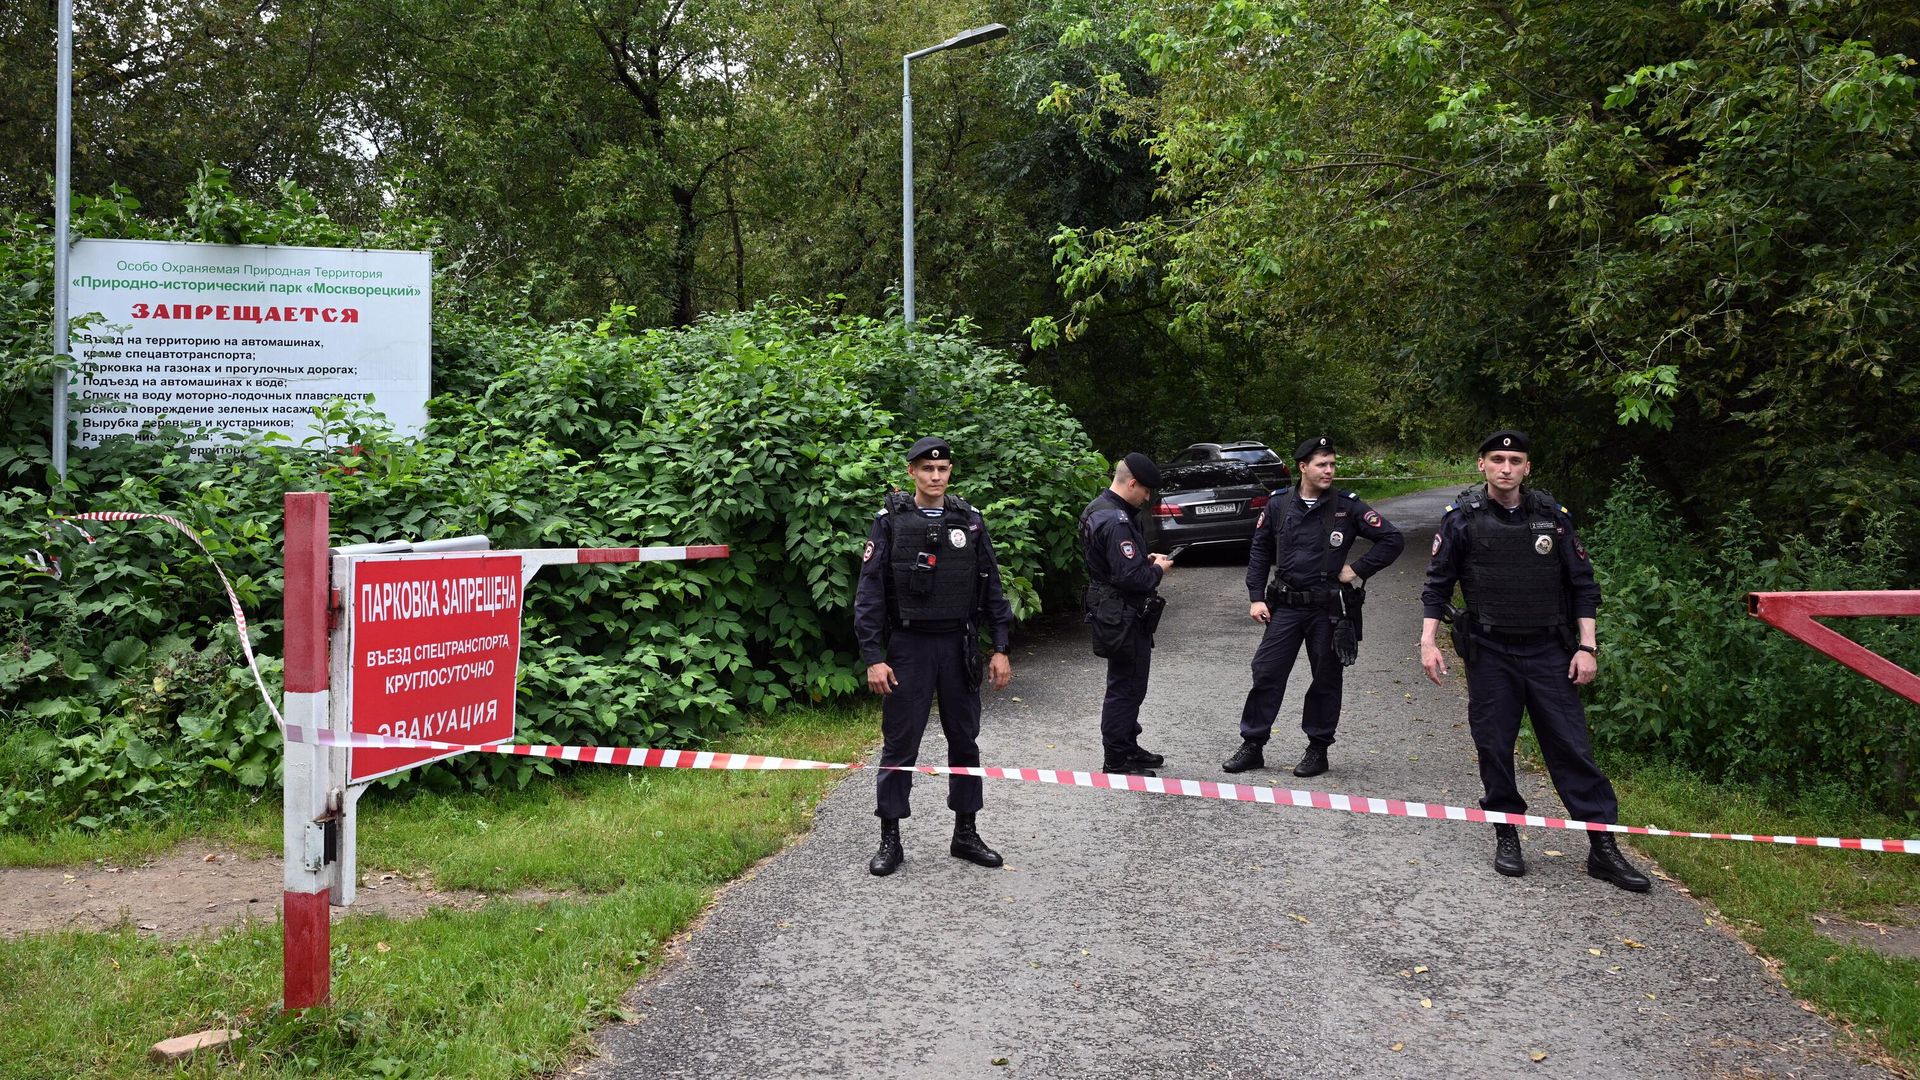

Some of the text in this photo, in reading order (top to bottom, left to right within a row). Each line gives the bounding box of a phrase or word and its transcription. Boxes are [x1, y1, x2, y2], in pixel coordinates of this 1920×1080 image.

[116, 260, 383, 280] Особо Охраняемая Природная Территория
[72, 275, 422, 298] «Природно-исторический парк «Москворецкий»
[131, 303, 360, 324] ЗАПРЕЩАЕТСЯ
[145, 338, 221, 348] территорию
[224, 338, 238, 346] на
[241, 338, 324, 349] автомашинах,
[125, 350, 256, 361] спецавтотранспорта;
[146, 365, 161, 373] на
[164, 365, 211, 373] газонах
[225, 365, 304, 376] прогулочных
[306, 367, 358, 376] дорогах;
[83, 377, 139, 387] Подъезд
[142, 379, 157, 387] на
[160, 379, 242, 387] автомашинах
[255, 379, 288, 388] воде;
[82, 390, 120, 401] Спуск
[124, 392, 138, 400] на
[142, 392, 172, 402] воду
[175, 391, 292, 402] моторно-лодочных
[131, 406, 214, 416] повреждение
[217, 406, 269, 414] зеленых
[82, 418, 294, 429] Вырубка деревев и кустарников;
[362, 575, 516, 623] ПАРКОВКА ЗАПРЕЩЕНА
[366, 633, 509, 667] ВЪЕЗД СПЕЦТРАНСПОРТА
[385, 659, 495, 695] КРУГЛОСУТОЧНО
[377, 699, 498, 745] ЭВАКУАЦИЯ
